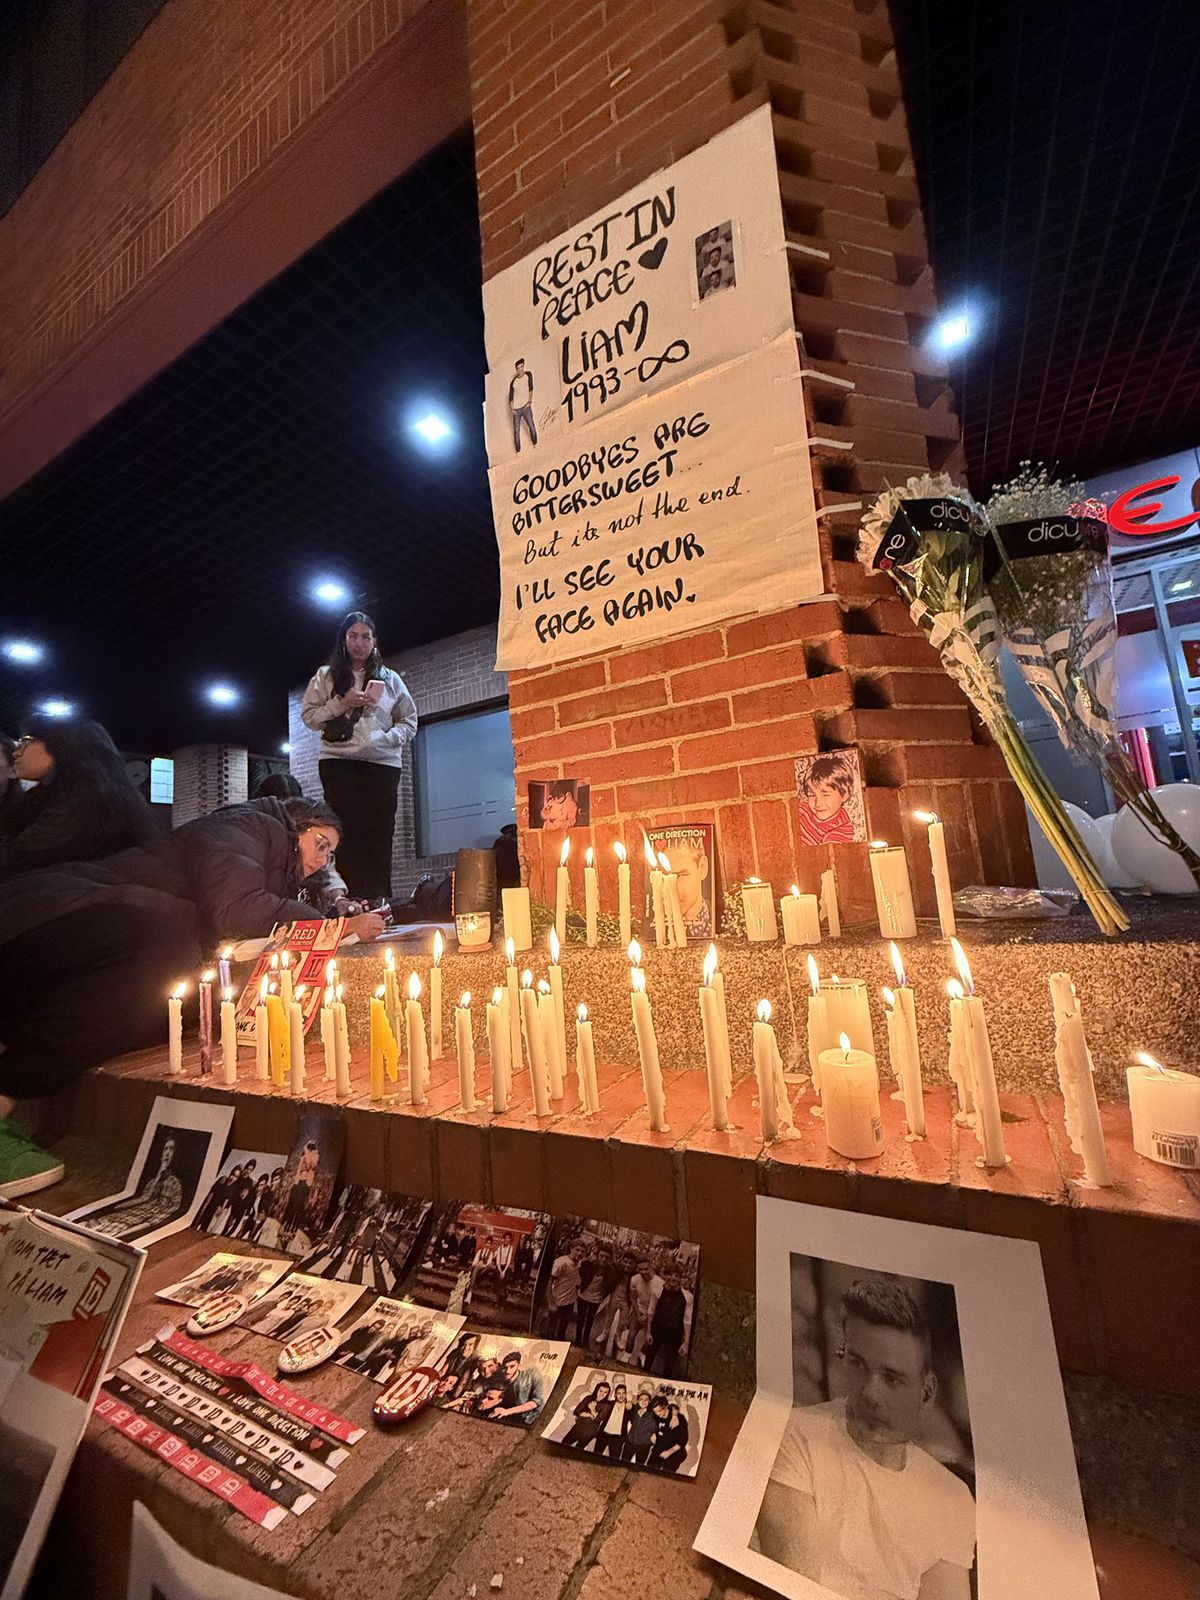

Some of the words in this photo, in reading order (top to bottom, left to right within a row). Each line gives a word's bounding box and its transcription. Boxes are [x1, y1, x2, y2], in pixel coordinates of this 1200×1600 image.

[532, 211, 623, 306] REST
[620, 186, 677, 251] IN
[541, 260, 635, 340] PEACE
[512, 436, 640, 505] GOODBYES
[653, 412, 711, 450] ARE
[523, 530, 561, 565] But
[608, 497, 644, 533] not
[651, 491, 690, 519] the
[515, 575, 555, 611] I'LL
[563, 559, 616, 596] SEE
[627, 532, 706, 575] YOUR
[535, 605, 596, 644] FACE
[649, 831, 664, 841] ONE
[665, 829, 706, 839] DIRECTION
[667, 837, 703, 849] LIAM
[291, 929, 317, 940] RED
[25, 1277, 69, 1306] LIAM
[539, 1352, 559, 1361] FOUR
[232, 1394, 256, 1410] LOVE
[252, 1405, 271, 1419] ONE
[266, 1414, 311, 1441] DIRECTION
